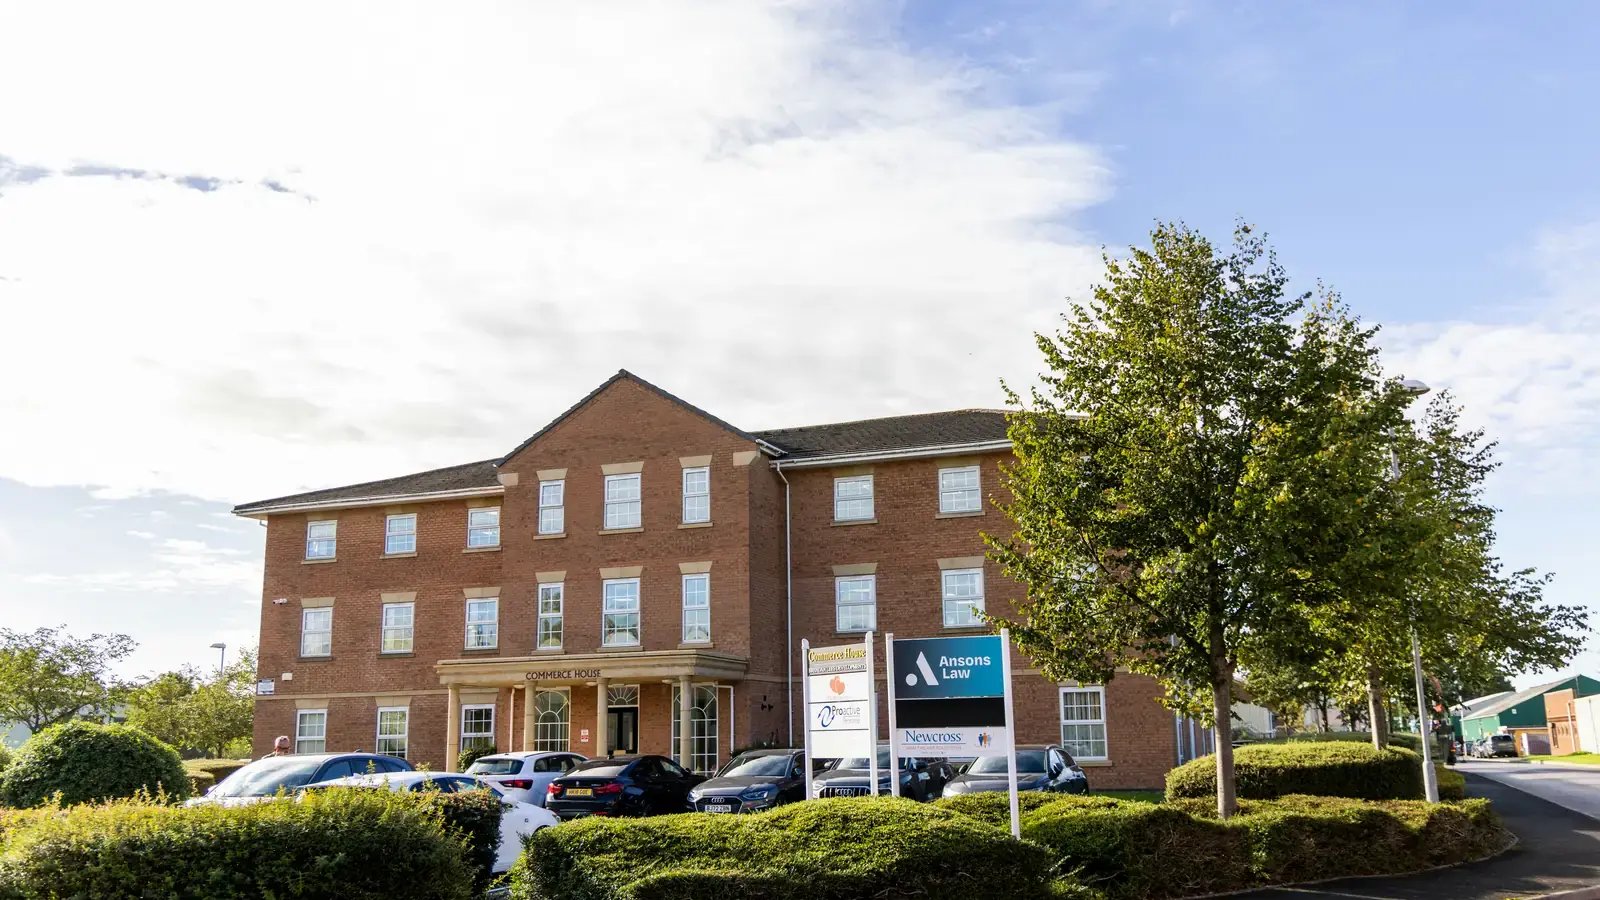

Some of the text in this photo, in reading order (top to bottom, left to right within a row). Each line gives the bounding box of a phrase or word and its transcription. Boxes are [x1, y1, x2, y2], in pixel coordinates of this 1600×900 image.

[809, 648, 867, 663] Commerce House
[939, 655, 991, 667] Ansons
[525, 669, 601, 681] COMMERCE HOUSE
[942, 668, 971, 679] Law
[832, 705, 861, 716] Proactive
[905, 730, 962, 742] Newcross
